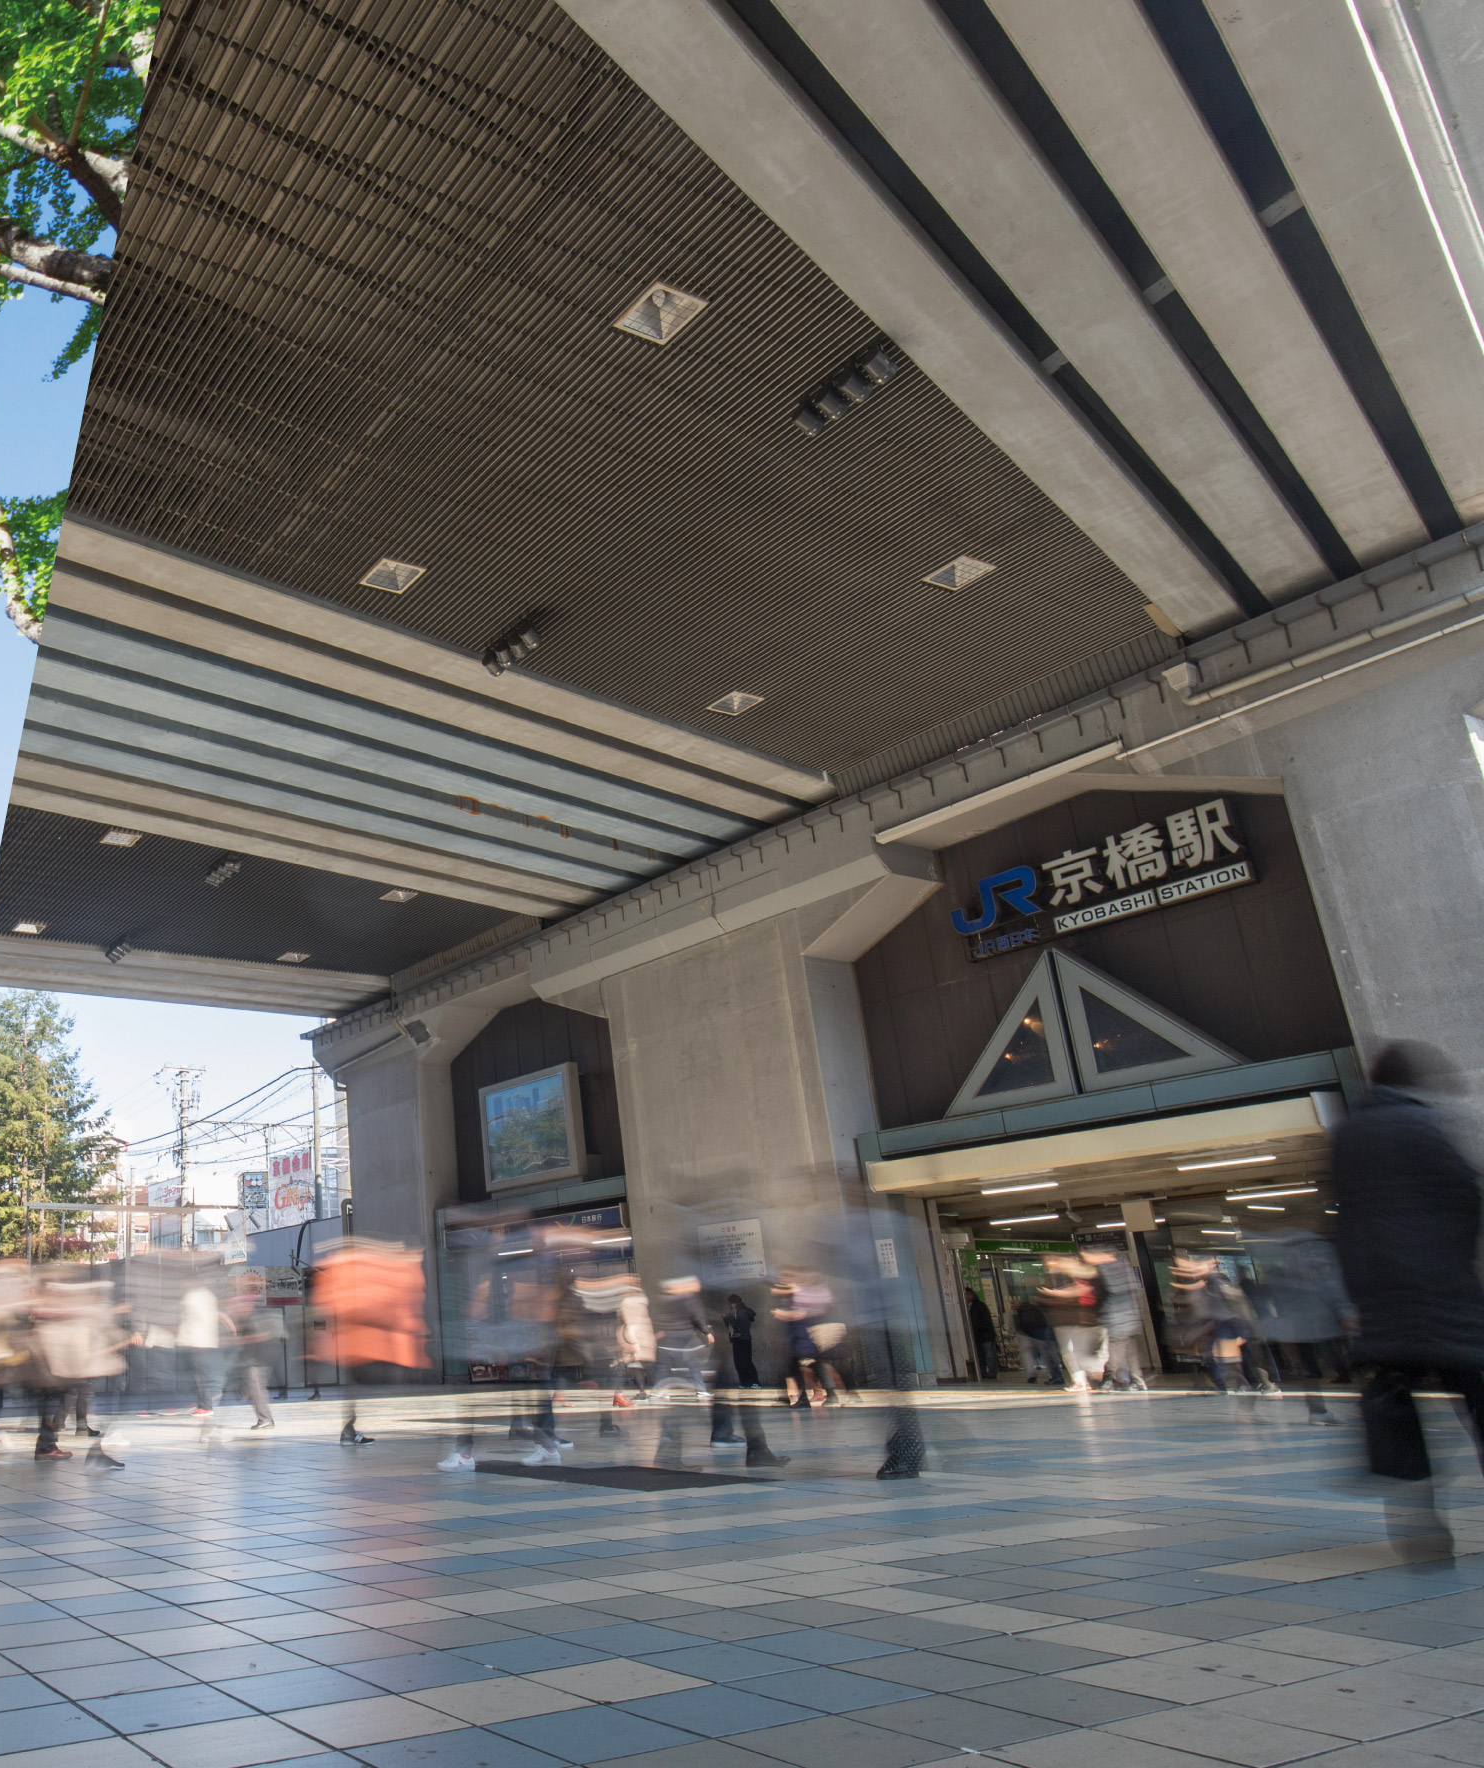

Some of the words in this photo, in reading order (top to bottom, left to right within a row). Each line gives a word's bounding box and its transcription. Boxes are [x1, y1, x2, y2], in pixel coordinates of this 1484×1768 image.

[950, 865, 1046, 935] JR
[1041, 798, 1240, 906] 京橋駅
[1056, 893, 1155, 930] KYOBASHI
[1161, 864, 1247, 901] STATION
